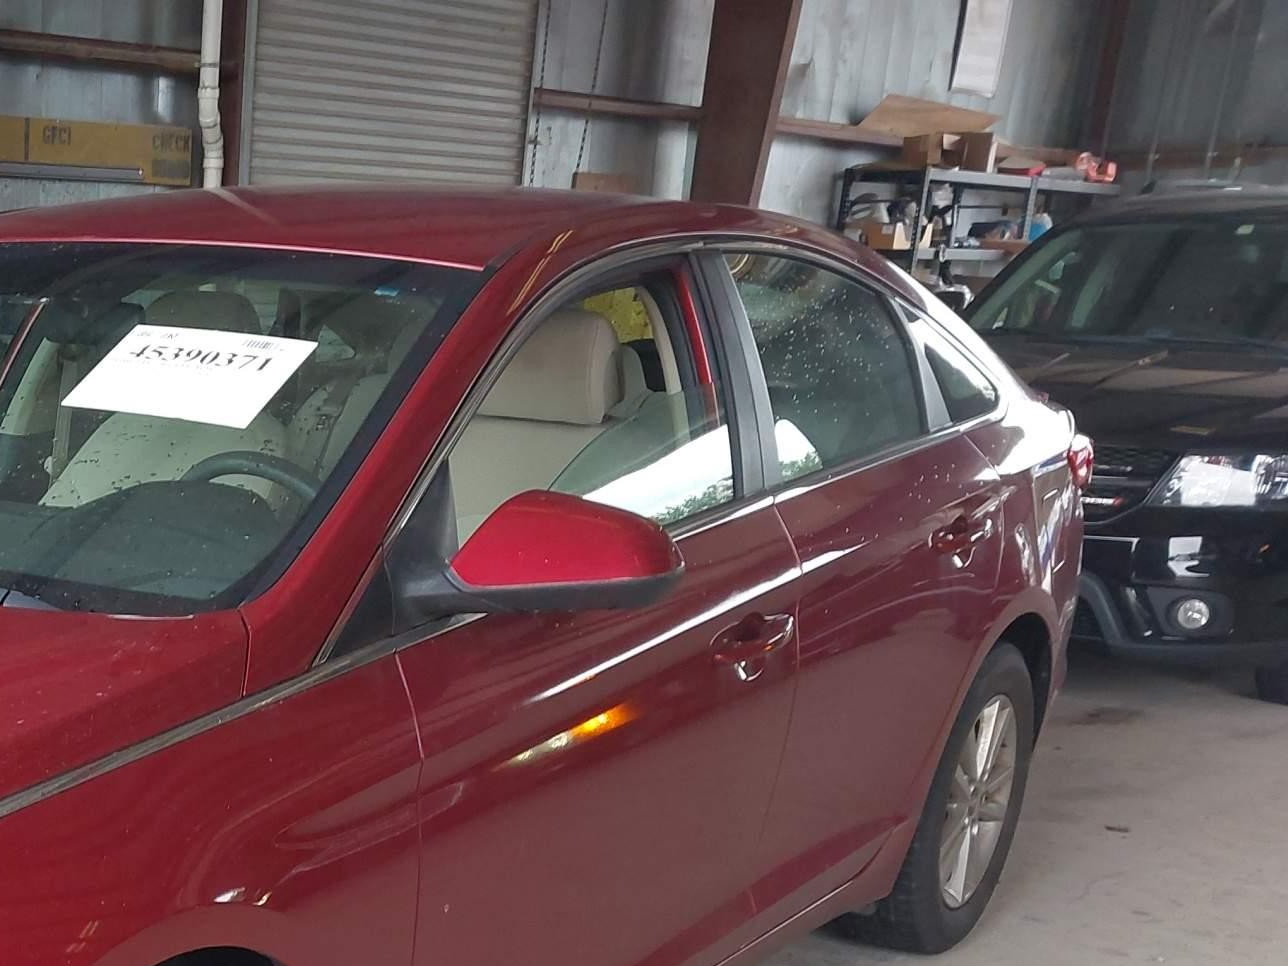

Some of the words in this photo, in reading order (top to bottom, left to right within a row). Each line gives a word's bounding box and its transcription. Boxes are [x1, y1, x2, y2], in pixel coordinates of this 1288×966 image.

[42, 125, 72, 145] GFCI
[152, 133, 190, 153] CHECK
[129, 344, 273, 372] 45390371
